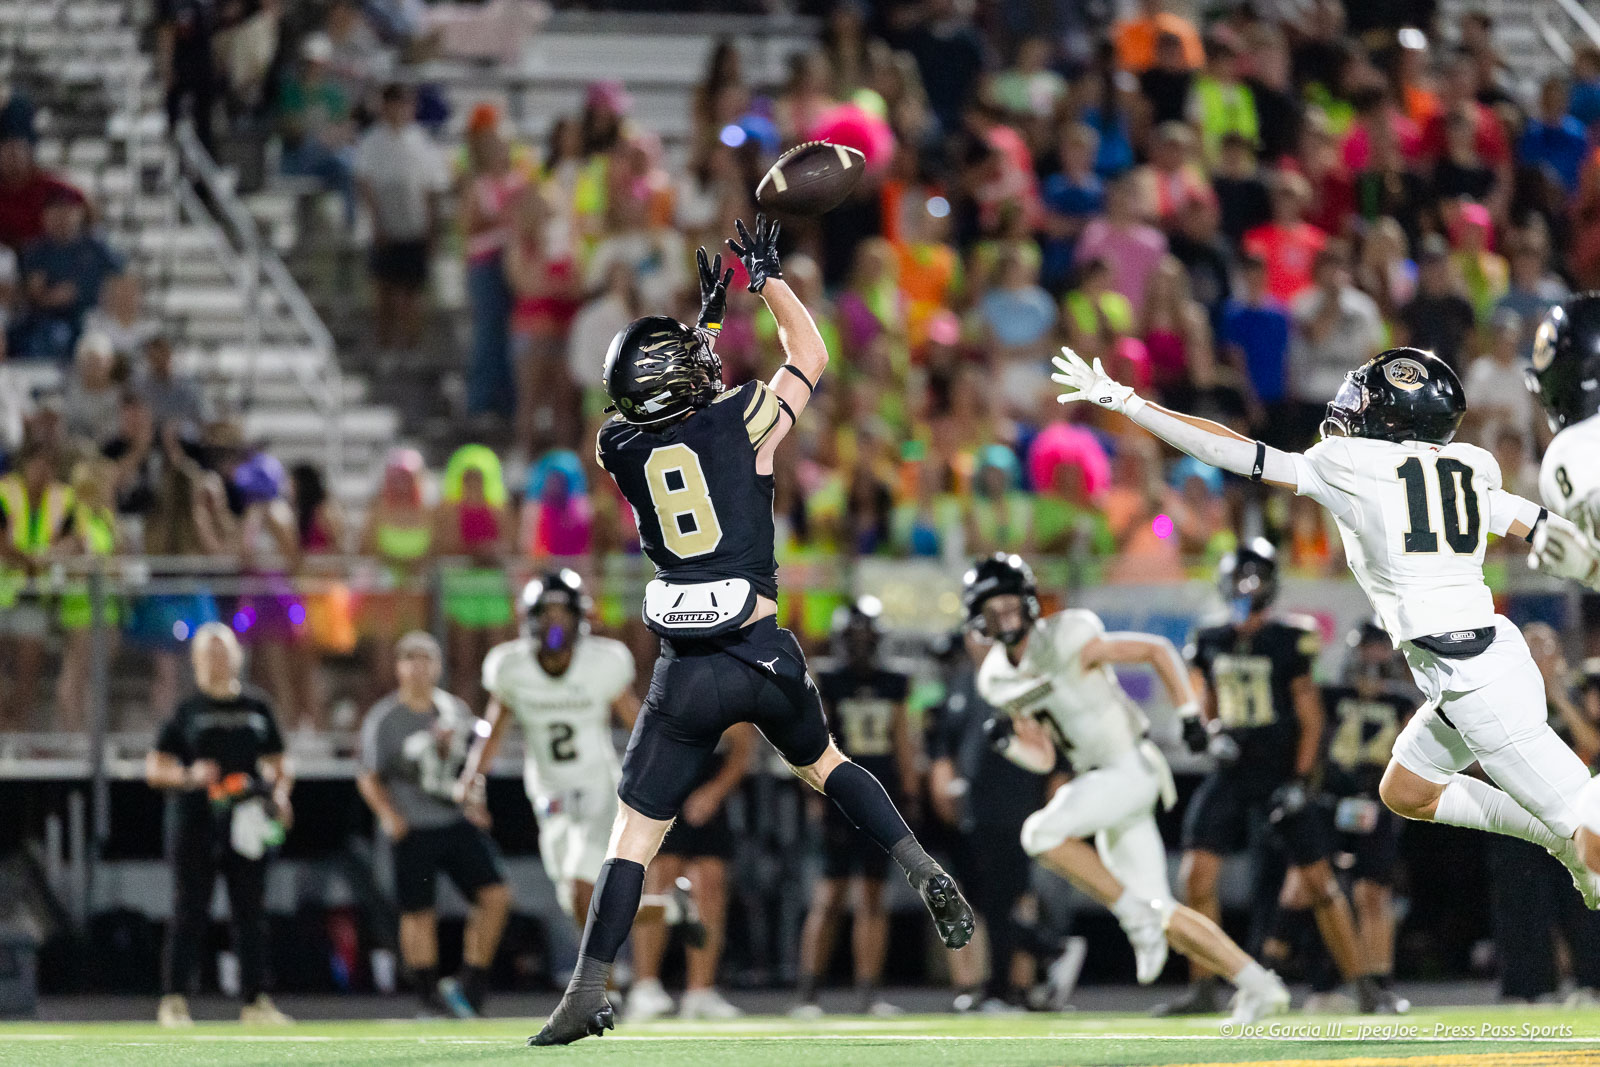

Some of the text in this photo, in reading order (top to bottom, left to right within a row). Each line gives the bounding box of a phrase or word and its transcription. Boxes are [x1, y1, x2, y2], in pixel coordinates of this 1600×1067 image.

[643, 442, 723, 560] 8
[1555, 465, 1575, 499] 8
[1395, 456, 1480, 556] 10
[667, 613, 715, 622] BATTLE
[549, 722, 578, 762] 2
